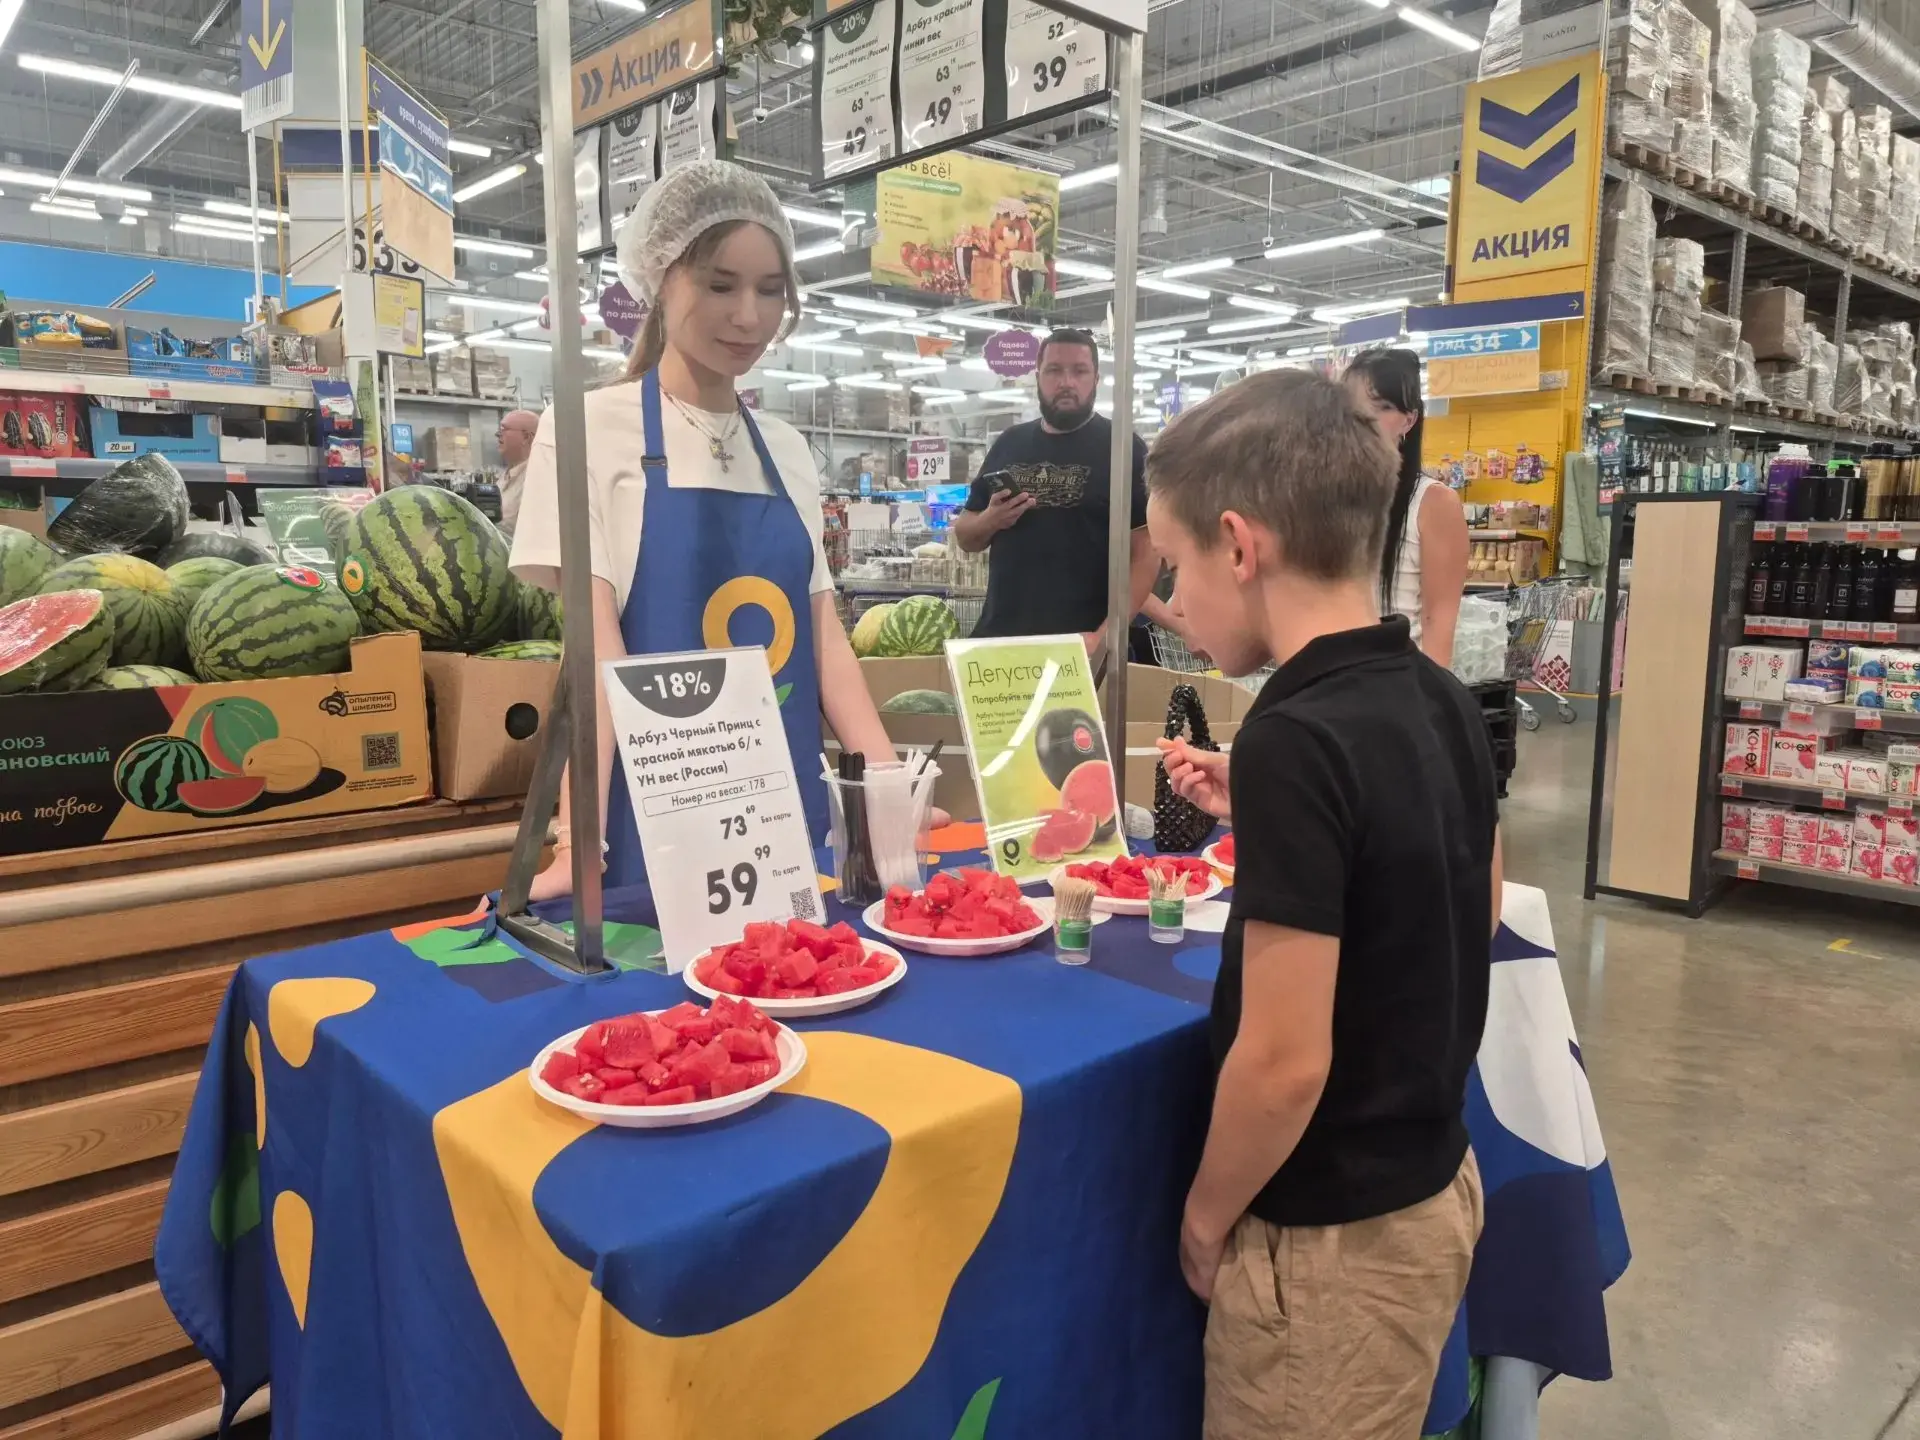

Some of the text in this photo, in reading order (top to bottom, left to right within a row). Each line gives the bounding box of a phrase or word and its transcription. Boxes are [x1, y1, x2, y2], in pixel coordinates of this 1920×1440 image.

[839, 11, 866, 34] -20%
[906, 0, 973, 34] Арбуз красный
[904, 30, 942, 52] мини вес
[1048, 22, 1064, 41] 52
[1543, 25, 1577, 41] INCANTO
[936, 65, 950, 82] 63
[1033, 55, 1067, 93] 39
[1065, 42, 1077, 55] 99
[672, 91, 694, 106] 26%
[851, 98, 864, 113] 63
[925, 85, 962, 128] 49 99
[619, 113, 639, 130] -18%
[405, 146, 425, 188] 25
[899, 162, 951, 180] ть всё!
[1472, 223, 1571, 263] АКЦИЯ
[998, 340, 1030, 349] Годовой
[1433, 332, 1501, 355] ряд 34
[922, 457, 937, 476] 29
[936, 457, 944, 465] 99
[968, 656, 1080, 687] Дегустаия!
[642, 671, 711, 699] -18%
[348, 694, 392, 704] ОПЫЛЕНИЕ
[352, 702, 392, 711] ШМЕЛЯМИ
[972, 693, 1022, 705] Попробуйте
[628, 718, 762, 747] Арбуз Черный Принц с
[633, 735, 762, 769] красной мякотью б/ к
[637, 760, 729, 788] УН вес (Россия)
[671, 778, 766, 810] Номер на весах: 178
[34, 796, 103, 826] подвое
[720, 805, 756, 840] 73 69
[761, 811, 792, 824] Без карты
[707, 845, 771, 914] 59 99
[772, 865, 801, 878] По карте
